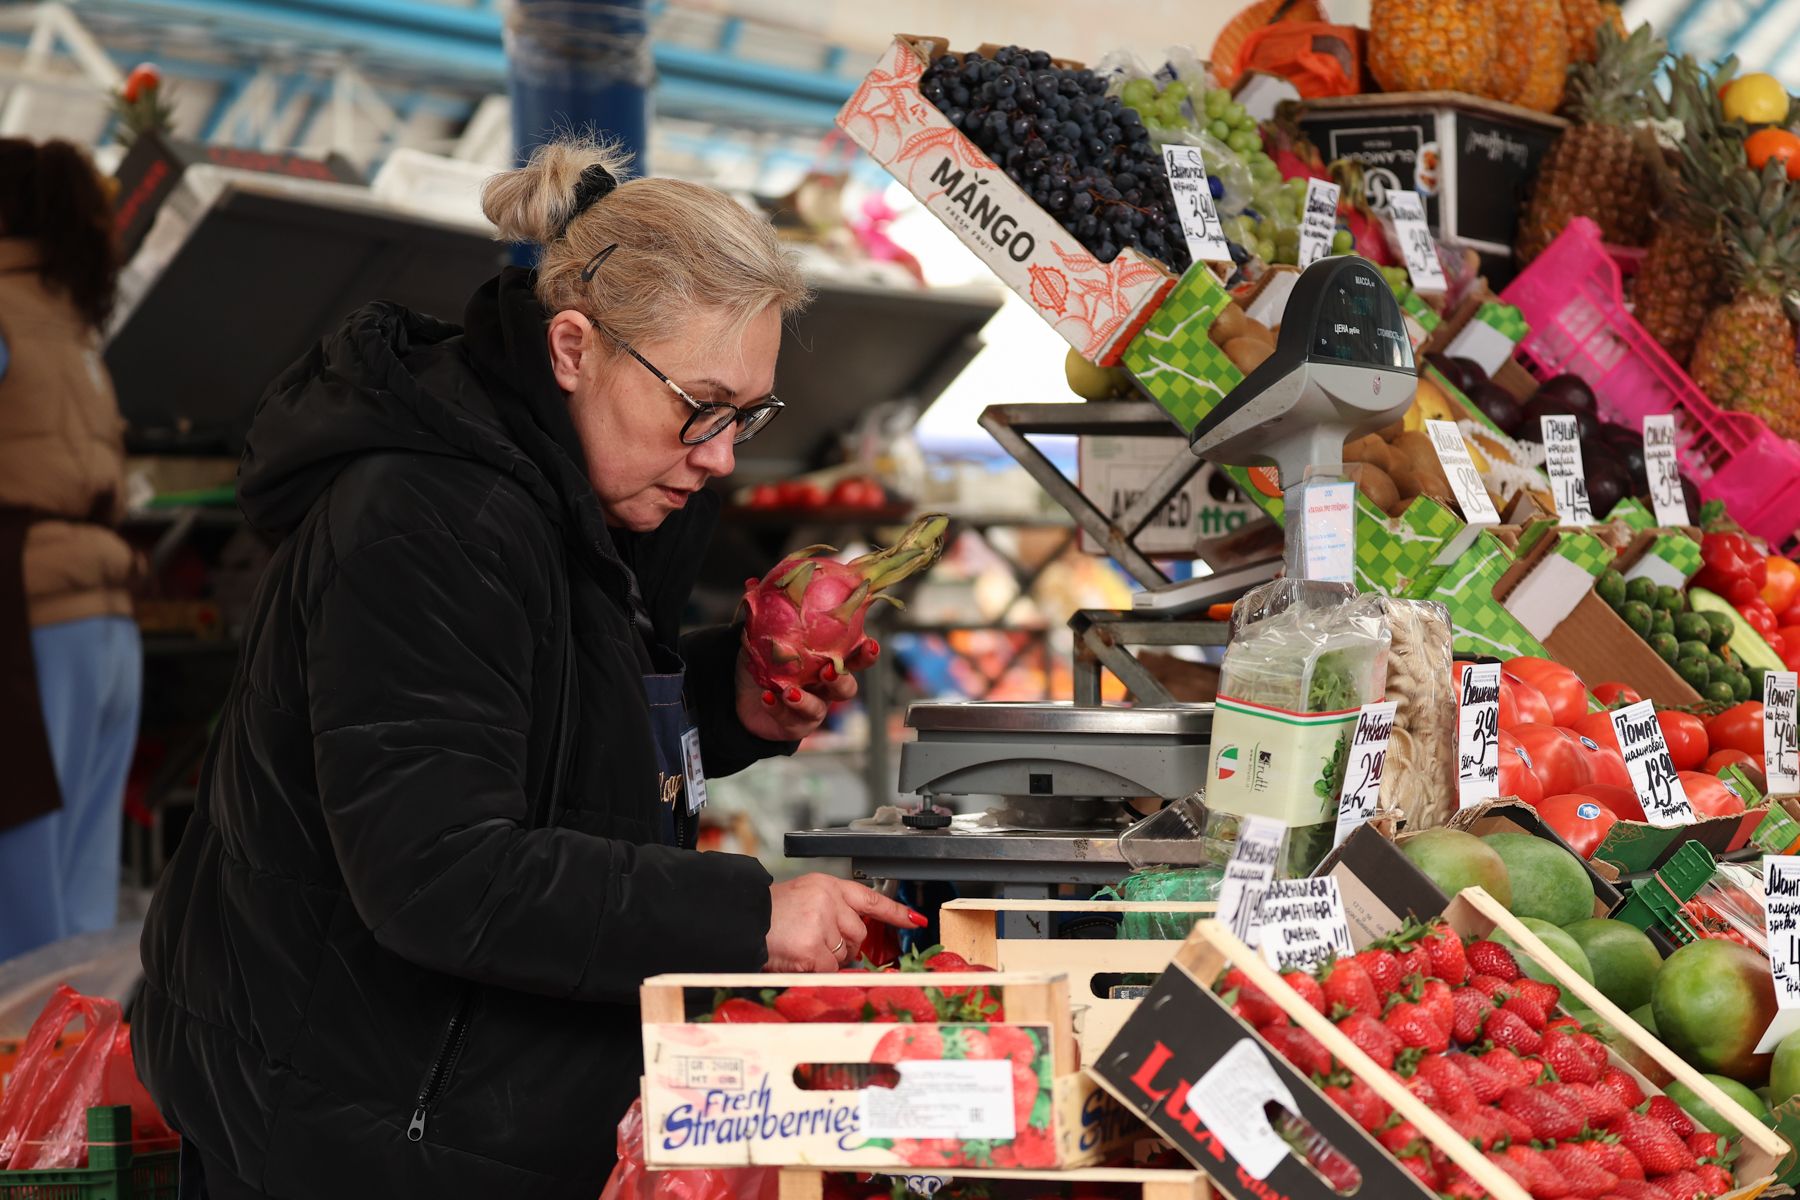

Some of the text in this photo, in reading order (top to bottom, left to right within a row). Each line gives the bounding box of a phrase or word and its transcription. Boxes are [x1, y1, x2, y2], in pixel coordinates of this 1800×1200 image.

[946, 206, 995, 253] FRESH FRUIT
[1334, 324, 1348, 335] ЦЕНА
[1765, 864, 1800, 897] Манг
[704, 1072, 771, 1117] Fresh
